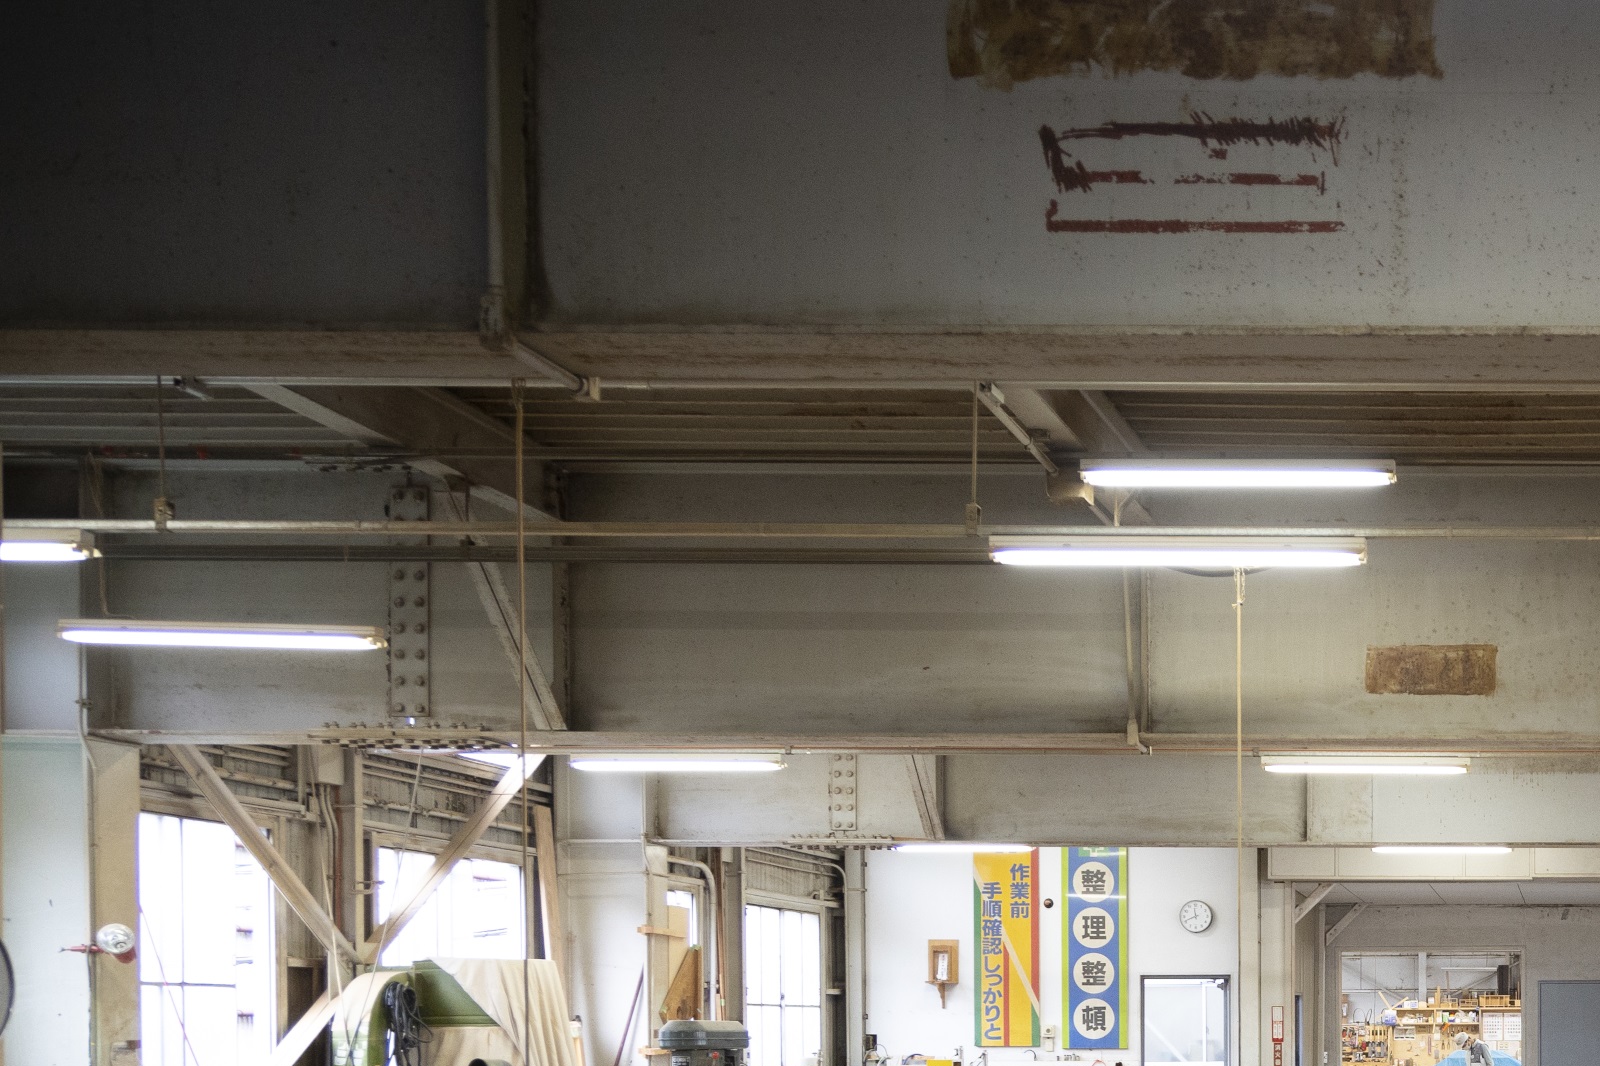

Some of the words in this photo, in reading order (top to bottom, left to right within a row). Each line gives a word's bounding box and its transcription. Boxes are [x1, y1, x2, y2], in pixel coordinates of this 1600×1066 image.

[982, 882, 1003, 1041] 手順確認しっかりと
[1009, 863, 1030, 919] 作業前
[1081, 869, 1107, 1032] 整理整頓
